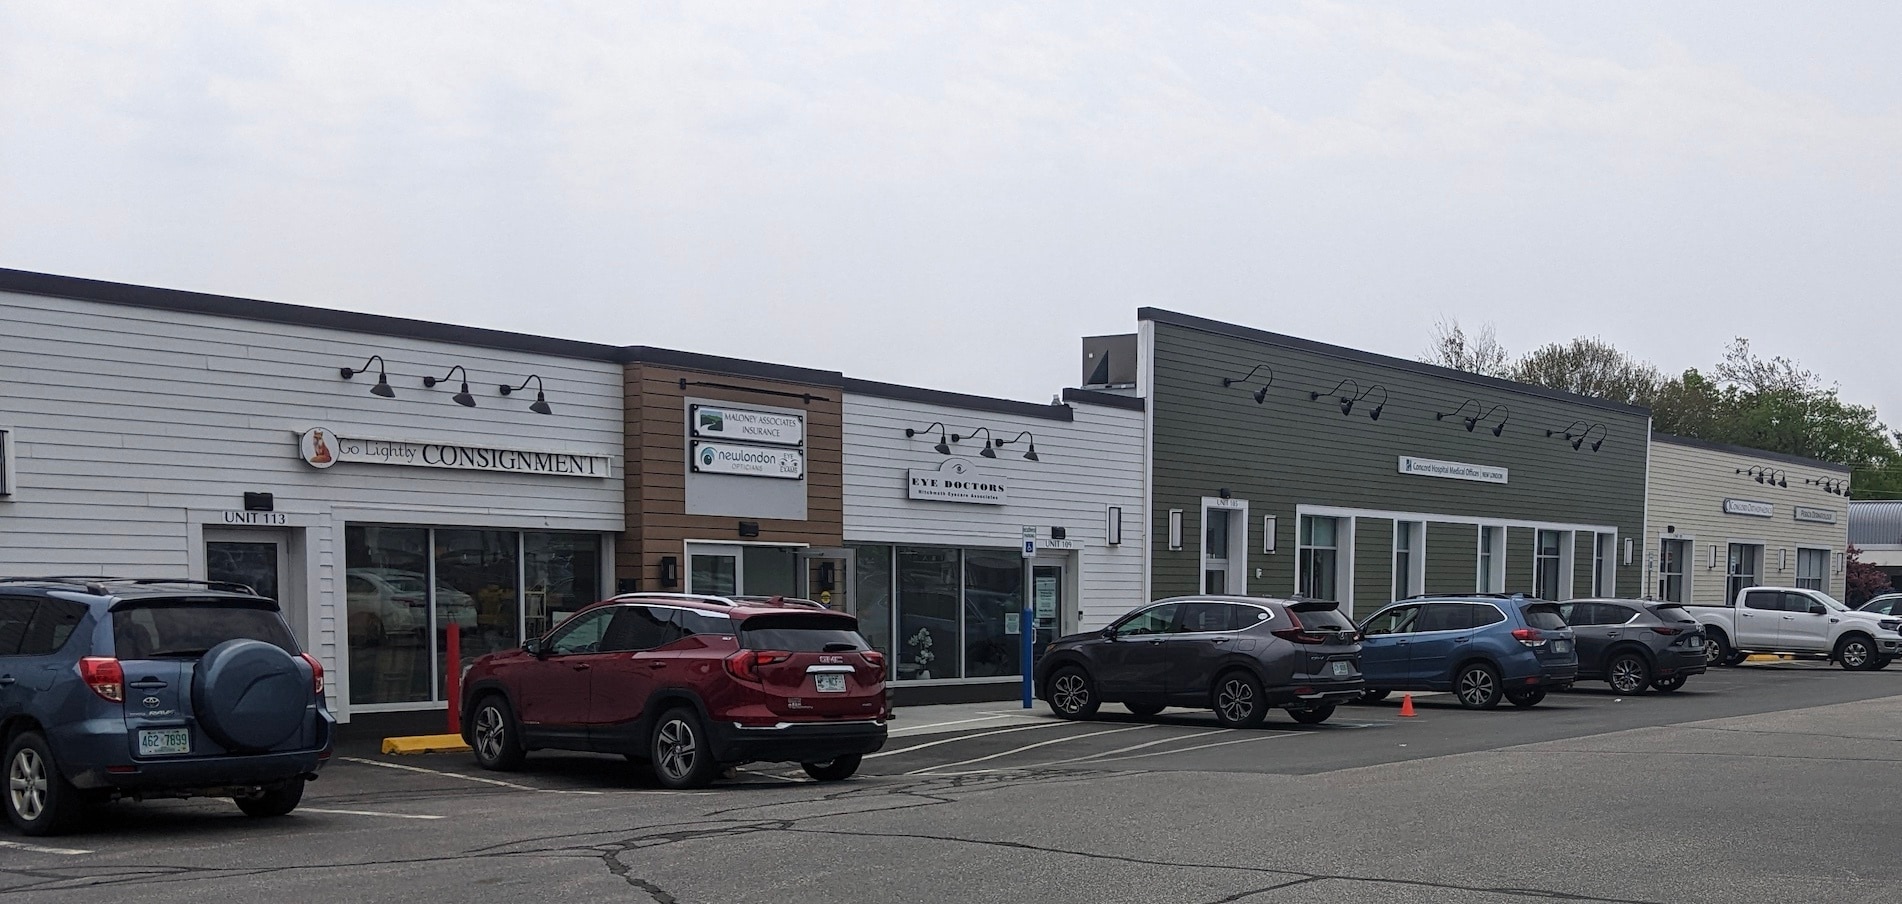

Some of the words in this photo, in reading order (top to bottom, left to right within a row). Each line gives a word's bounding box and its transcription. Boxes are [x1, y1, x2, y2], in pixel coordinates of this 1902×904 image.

[724, 413, 758, 424] MALONEY
[759, 417, 797, 428] ASSOCIATES
[742, 426, 781, 437] INSURANCE
[339, 438, 359, 455] Go
[365, 441, 417, 464] Lightly
[422, 443, 601, 476] CONSIGNMENT
[718, 450, 776, 464] newlondon
[731, 463, 763, 472] OPTICIANS
[780, 465, 798, 474] EXAMS
[1413, 462, 1431, 472] Concord
[1432, 464, 1449, 475] Hospital
[1450, 467, 1465, 476] Medical
[1466, 468, 1480, 477] Offices
[912, 477, 938, 488] EYE
[944, 480, 1005, 493] DOCTORS
[225, 511, 258, 524] UNIT
[264, 513, 286, 525] 113
[1045, 540, 1061, 549] UNIT
[1062, 541, 1072, 549] 109
[819, 655, 844, 664] GMC
[142, 734, 160, 747] 462
[164, 733, 187, 747] 7899
